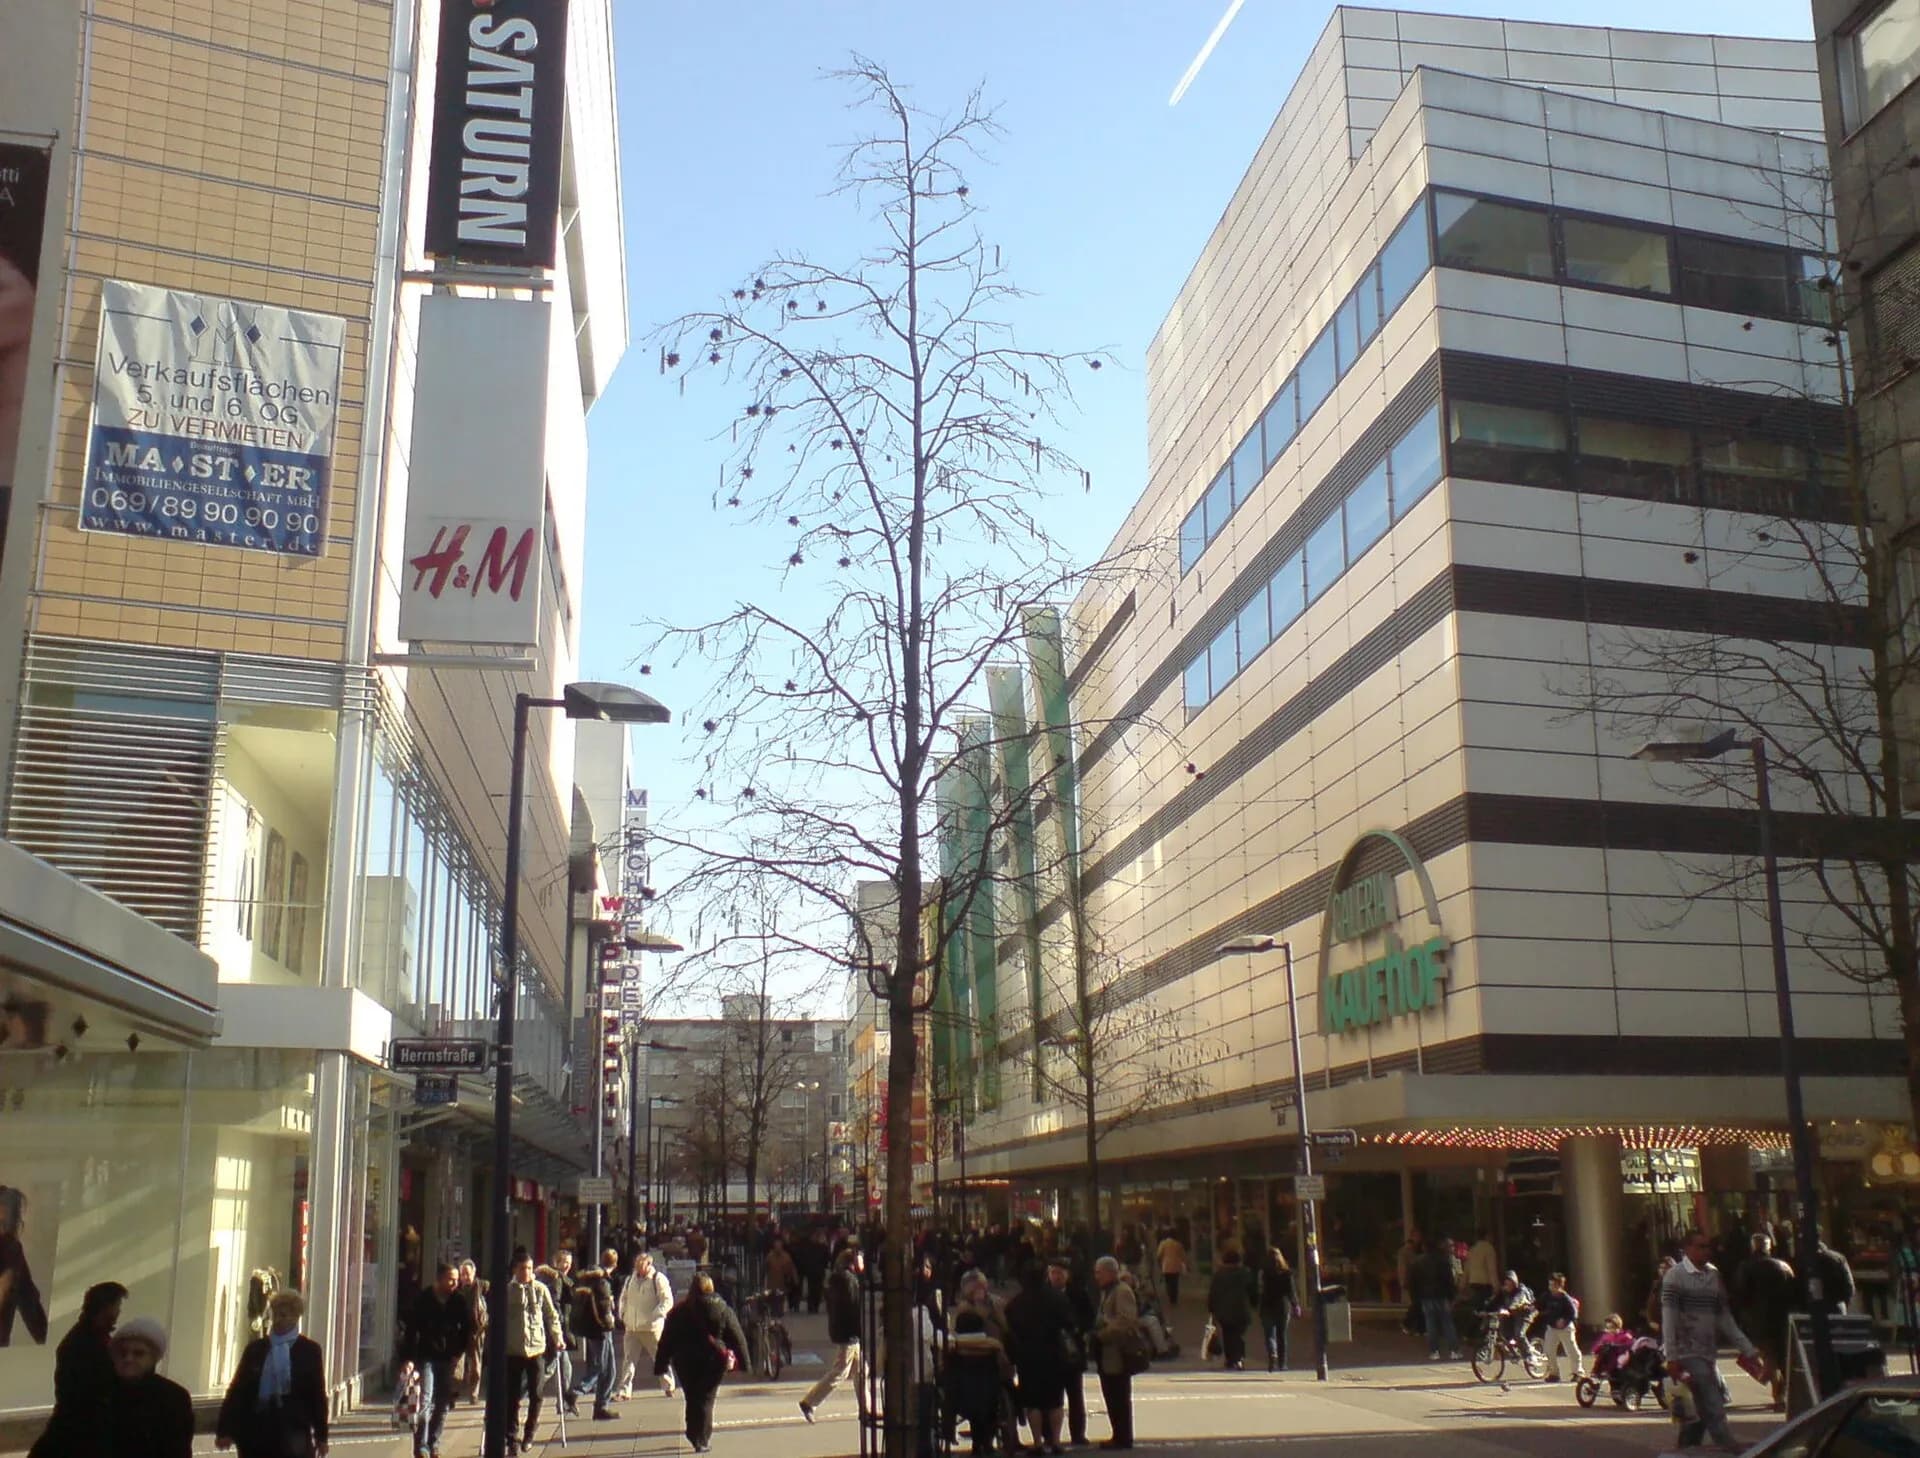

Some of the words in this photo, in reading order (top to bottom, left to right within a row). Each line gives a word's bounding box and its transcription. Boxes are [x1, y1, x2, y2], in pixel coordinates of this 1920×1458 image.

[457, 13, 538, 247] SATURN
[109, 352, 331, 405] Verkaufsflächen
[137, 384, 157, 407] 5.
[171, 393, 214, 414] und
[227, 397, 247, 421] 6.
[260, 402, 298, 425] OG
[127, 408, 160, 429] ZU
[171, 415, 303, 449] VERMIETEN
[204, 501, 238, 524] 90
[244, 506, 278, 529] 90
[286, 512, 319, 534] 90
[410, 524, 534, 602] H&M
[401, 1048, 475, 1063] Herrnstraße
